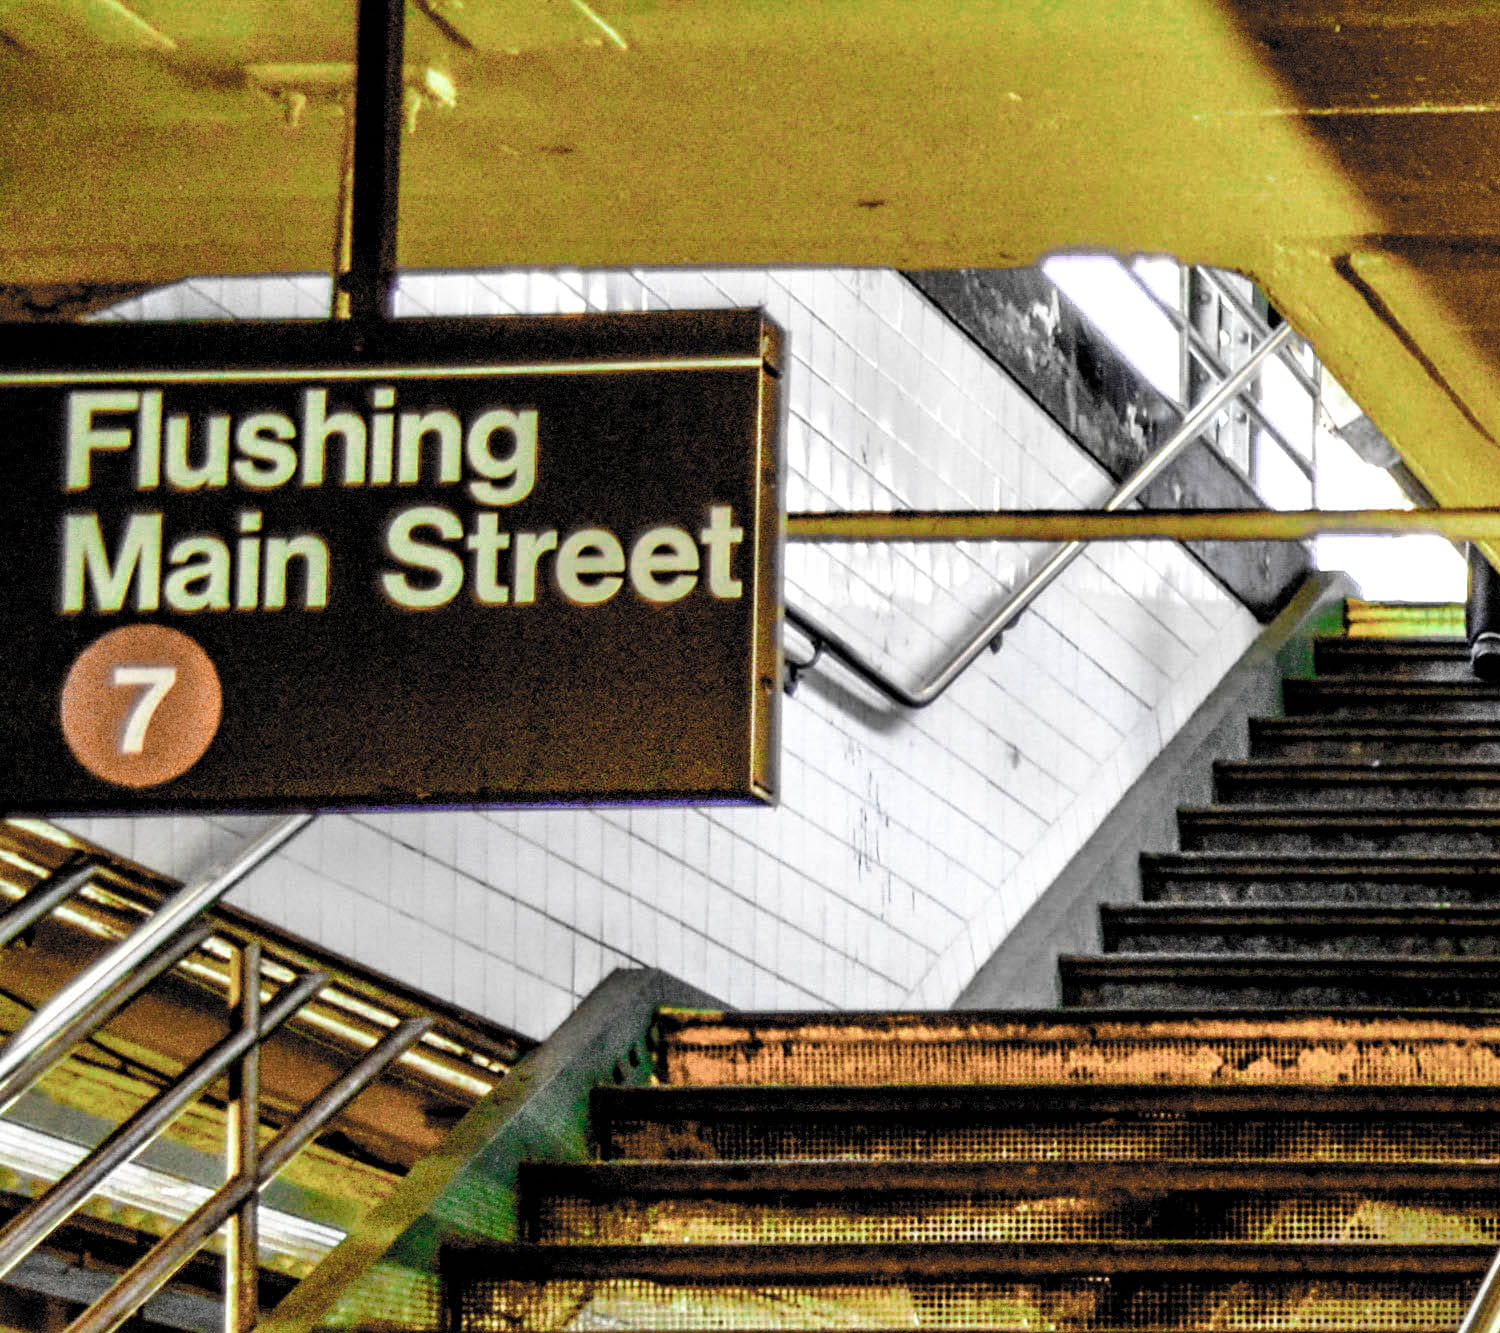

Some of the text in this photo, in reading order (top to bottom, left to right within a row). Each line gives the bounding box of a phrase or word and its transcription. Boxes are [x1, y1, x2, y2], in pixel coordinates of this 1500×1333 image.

[63, 388, 541, 506] Flushing
[59, 504, 745, 615] Main Street
[111, 664, 177, 757] 7
